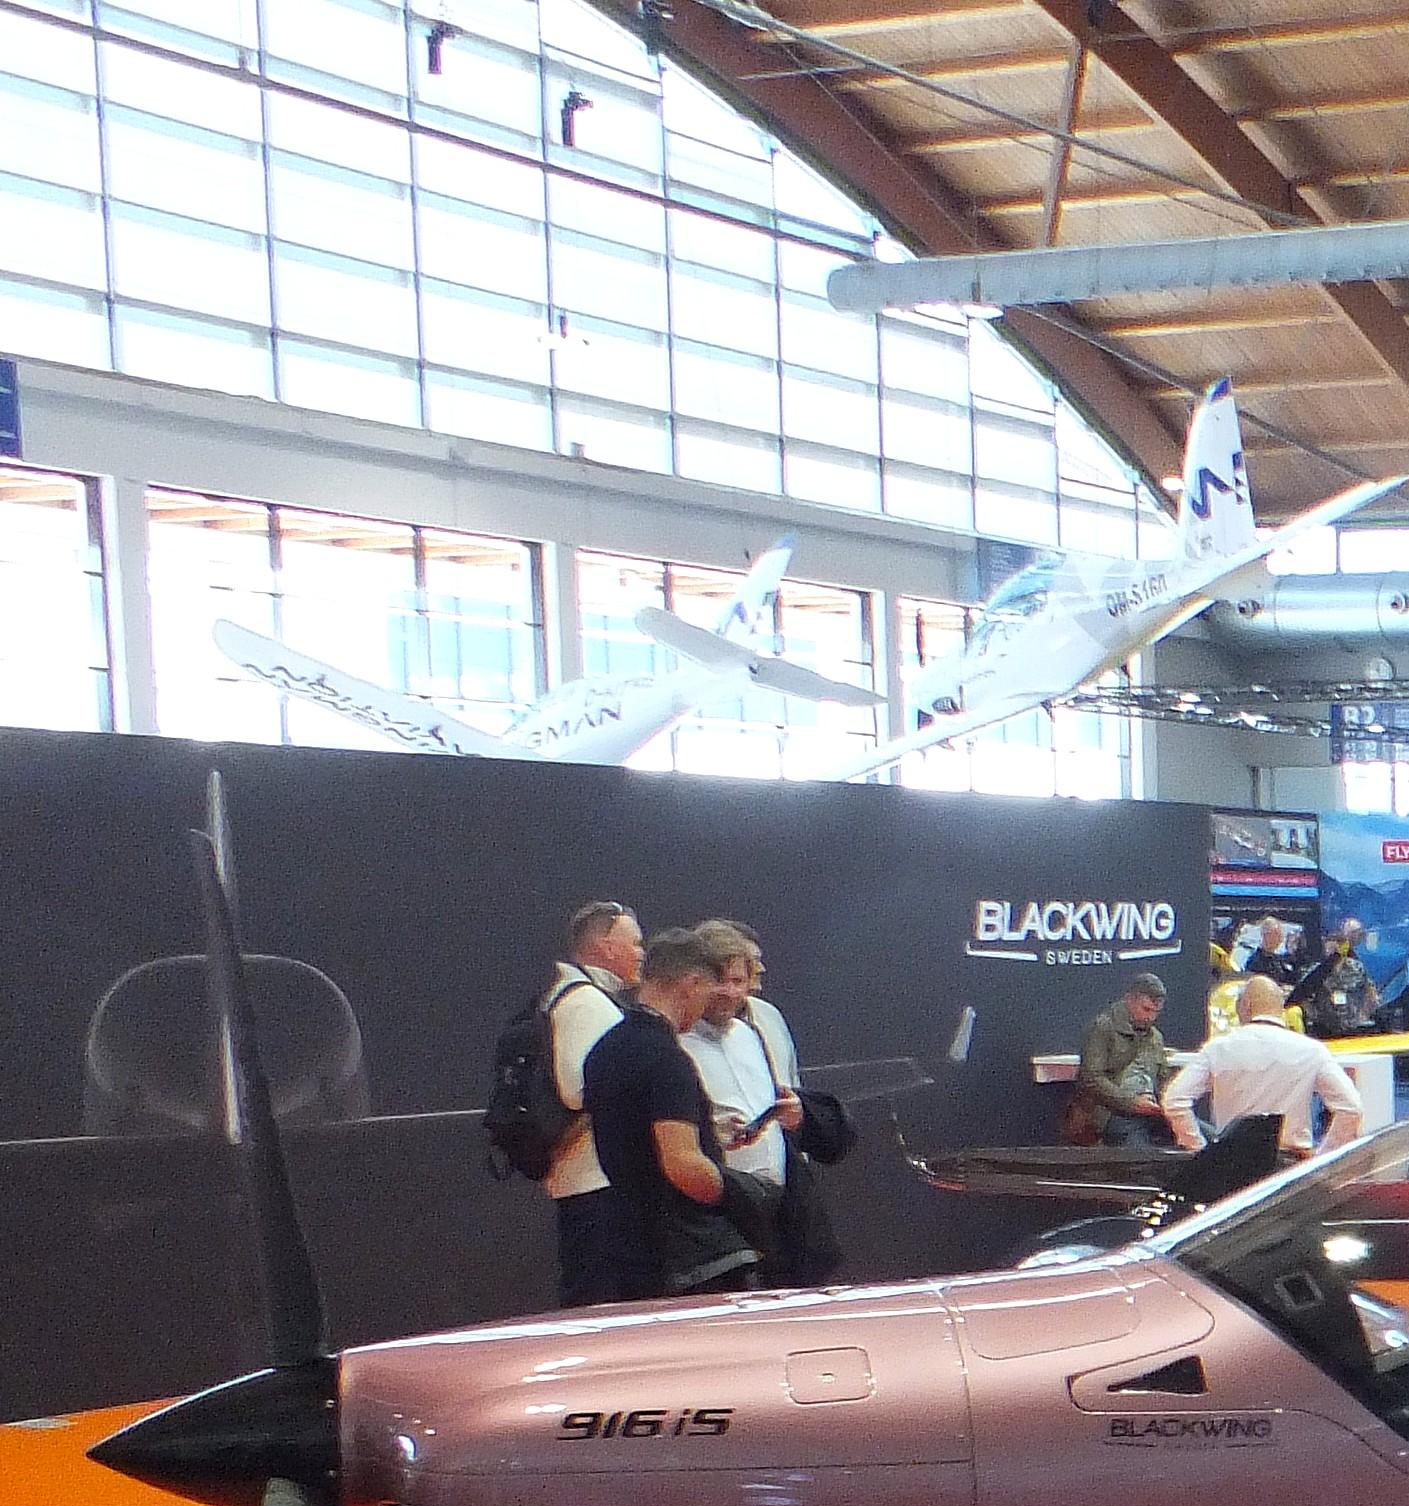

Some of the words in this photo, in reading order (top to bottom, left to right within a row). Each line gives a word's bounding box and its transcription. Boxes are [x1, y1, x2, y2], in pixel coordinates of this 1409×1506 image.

[977, 900, 1177, 941] BLACKWING
[1045, 950, 1113, 965] SWEDEN
[1110, 1418, 1273, 1438] BLACKWING
